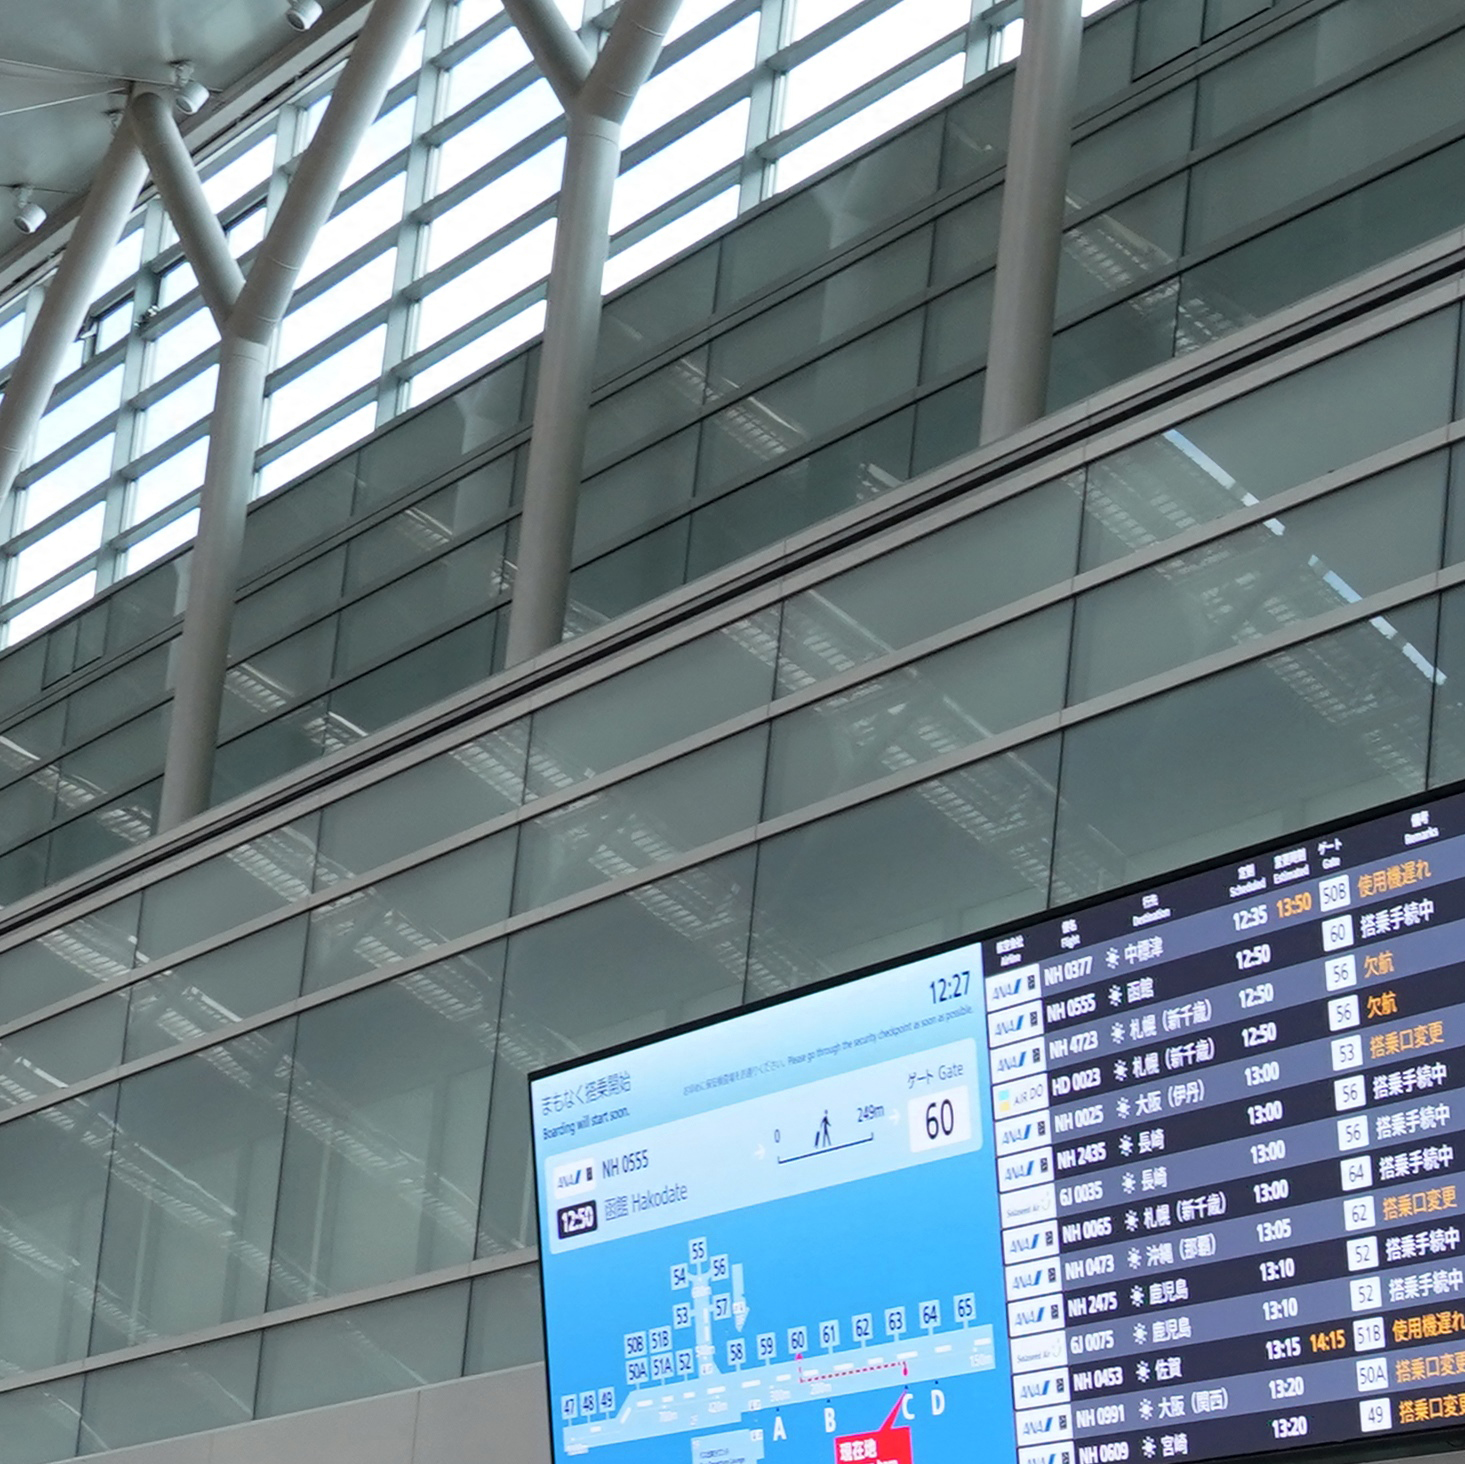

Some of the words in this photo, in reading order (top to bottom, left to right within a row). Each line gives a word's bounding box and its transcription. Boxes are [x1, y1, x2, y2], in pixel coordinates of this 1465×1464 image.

[1044, 965, 1063, 985] NH
[1065, 956, 1092, 979] 0377
[1234, 905, 1267, 930] 12:35
[1277, 892, 1311, 917] 13:50
[1324, 882, 1345, 902] 50B
[1047, 1002, 1065, 1022] NH
[1067, 994, 1095, 1016] 0555
[1237, 945, 1270, 969] 12:50
[1331, 923, 1344, 943] 60
[1361, 899, 1433, 938] 搭乗手続中
[930, 971, 970, 1004] 12:27
[907, 1070, 934, 1089] ゲート
[938, 1062, 963, 1081] Gate
[543, 1121, 575, 1140] Boarding
[577, 1115, 590, 1130] will
[591, 1112, 608, 1126] start
[857, 1105, 885, 1123] 249m
[925, 1099, 954, 1140] 60
[602, 1157, 619, 1179] NH
[622, 1149, 649, 1173] 0555
[605, 1195, 628, 1221] 函館
[632, 1184, 687, 1213] Hakodate
[561, 1205, 595, 1233] 12:50
[692, 1241, 705, 1260] 55
[958, 1298, 973, 1319] 65
[627, 1335, 643, 1354] 50B
[1074, 1372, 1092, 1390] NH
[1094, 1367, 1122, 1387] 0453
[1156, 1358, 1181, 1380] 佐賀
[1266, 1337, 1300, 1359] 13:15
[1310, 1330, 1345, 1352] 14:15
[1358, 1324, 1380, 1342] 51B
[902, 1393, 915, 1420] C
[931, 1389, 945, 1415] D
[773, 1416, 787, 1441] A
[824, 1407, 836, 1433] B
[1079, 1446, 1098, 1464] NH
[1100, 1442, 1128, 1462] 0609
[1161, 1434, 1187, 1456] 宮崎
[1273, 1416, 1307, 1437] 13:20
[1368, 1408, 1383, 1421] 49
[839, 1438, 877, 1462] 現在地
